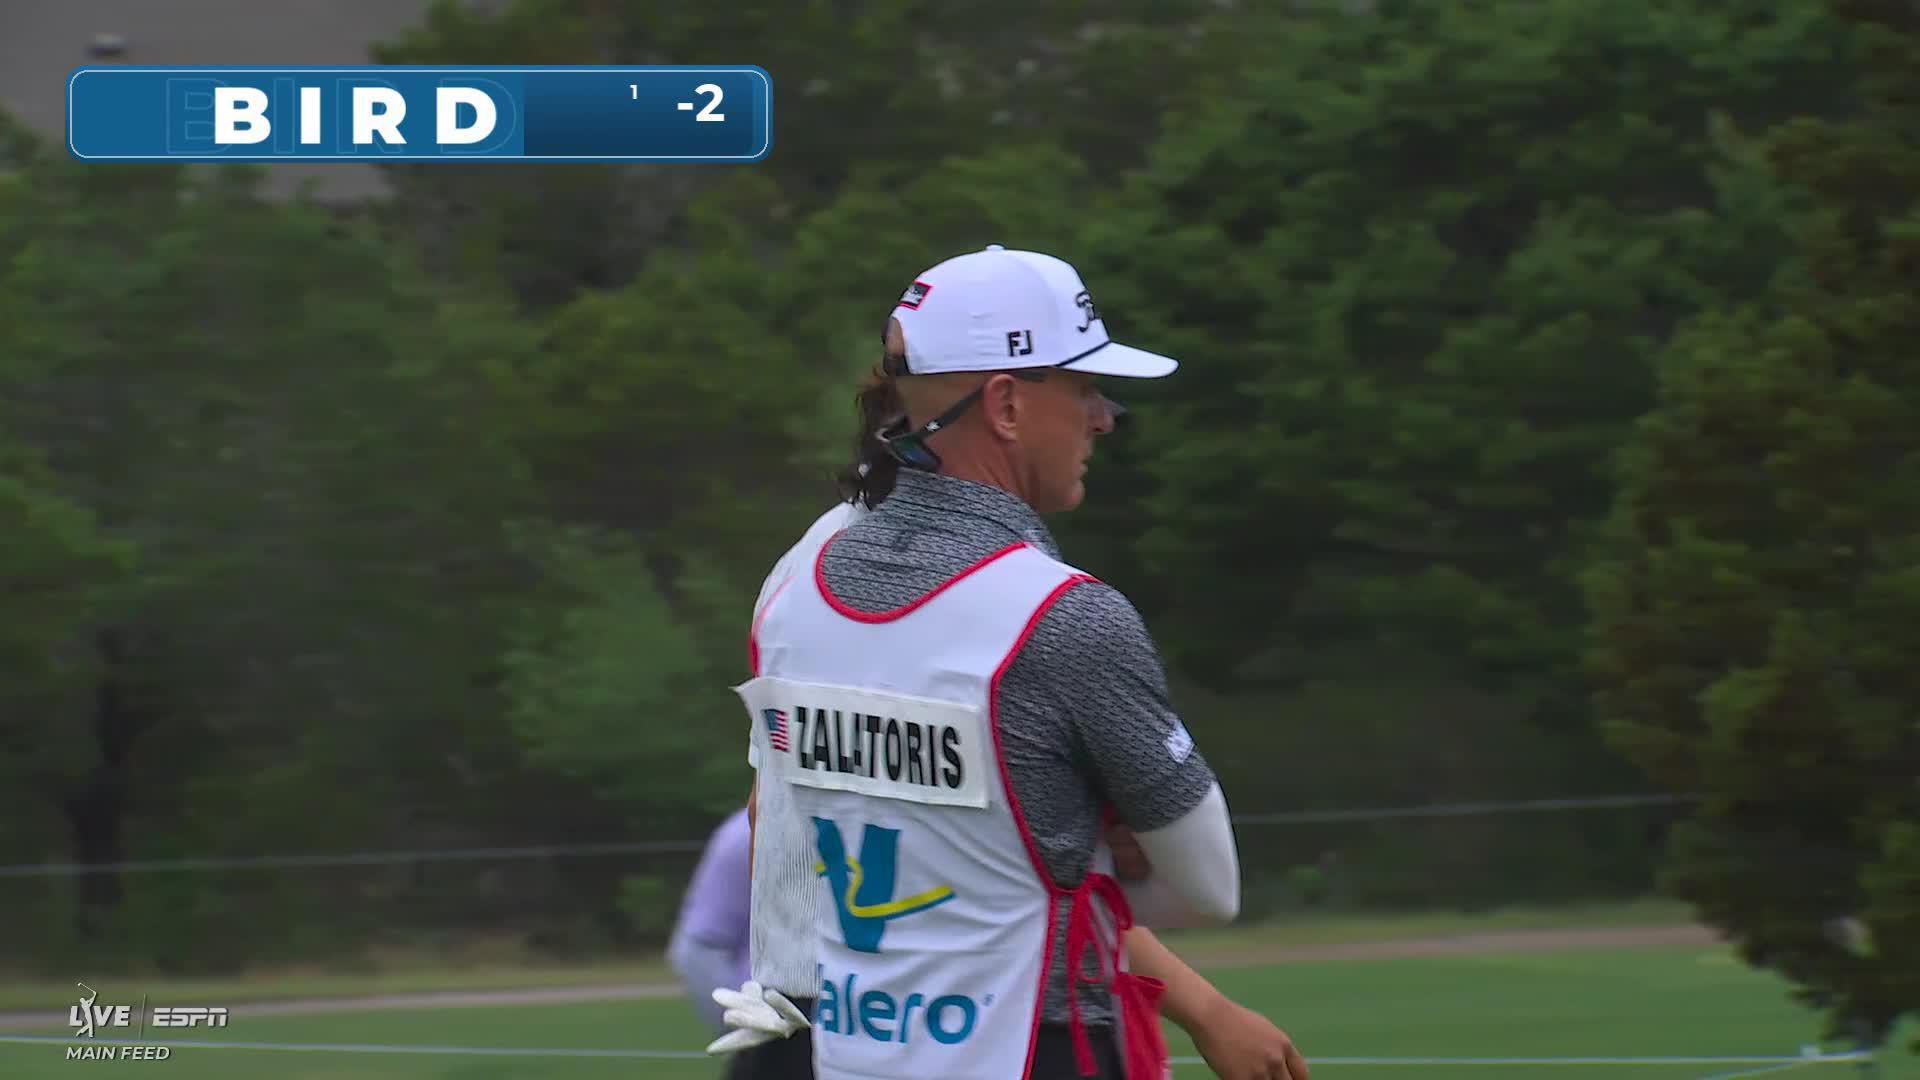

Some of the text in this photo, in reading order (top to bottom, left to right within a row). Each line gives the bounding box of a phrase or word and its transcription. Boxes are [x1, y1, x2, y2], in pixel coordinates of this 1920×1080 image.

[1007, 330, 1033, 357] FJ
[795, 705, 963, 789] ZALATORIS
[817, 963, 977, 1045] alero
